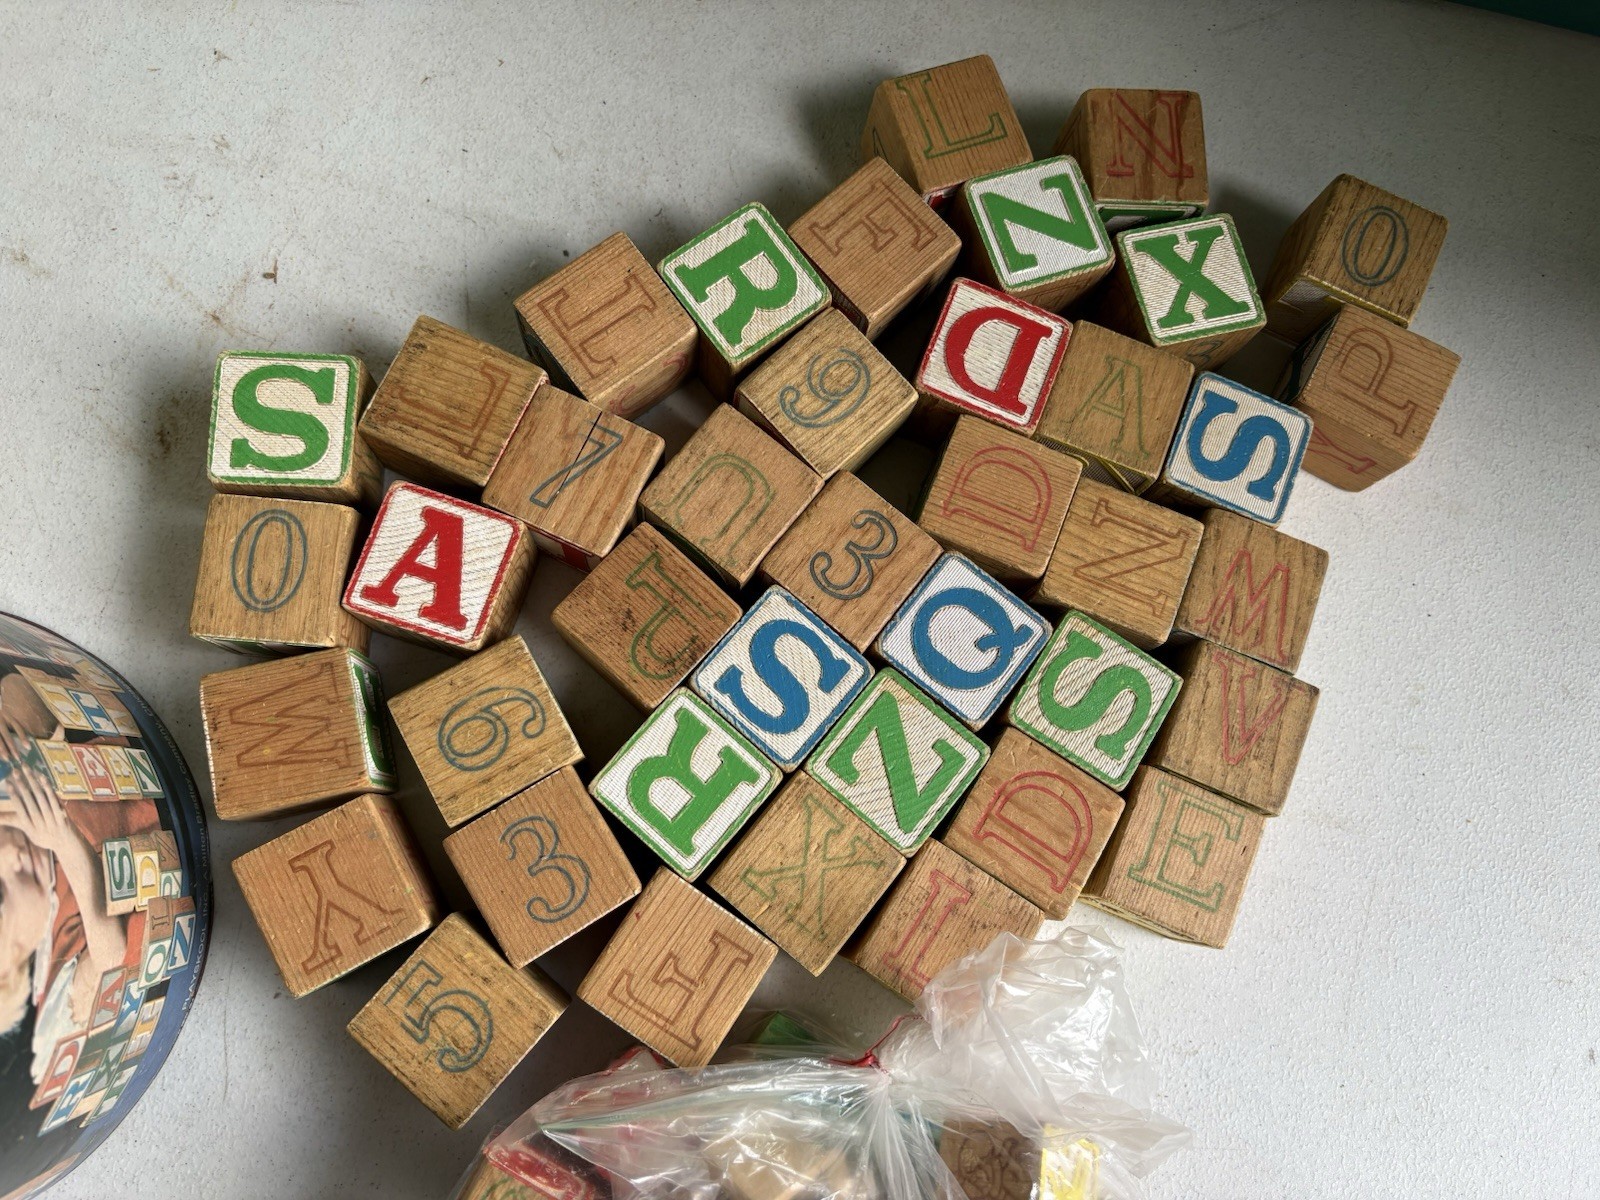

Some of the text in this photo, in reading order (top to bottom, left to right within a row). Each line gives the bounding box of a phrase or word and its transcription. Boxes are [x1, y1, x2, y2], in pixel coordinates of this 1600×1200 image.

[896, 71, 1008, 159] L
[1106, 91, 1193, 178] N
[808, 178, 938, 258] F
[674, 219, 798, 348] R
[1133, 225, 1250, 329] X
[944, 306, 1053, 416] D
[1059, 355, 1150, 459] A
[1327, 327, 1417, 438] P
[230, 364, 336, 472] S
[1188, 390, 1290, 502] S
[941, 446, 1053, 551] D
[360, 505, 469, 631] A
[809, 509, 899, 600] 3
[714, 619, 851, 734] S
[912, 587, 1034, 691] Q
[1039, 630, 1152, 761] S
[1213, 652, 1305, 764] V
[627, 707, 760, 857] R
[972, 770, 1093, 893] D
[106, 847, 135, 890] S
[501, 816, 590, 924] 3
[740, 794, 886, 942] X
[1128, 780, 1245, 912] E
[289, 839, 406, 975] Y
[181, 923, 208, 1011] PLAYSKOOL
[383, 960, 493, 1073] 5
[607, 930, 754, 1051] F
